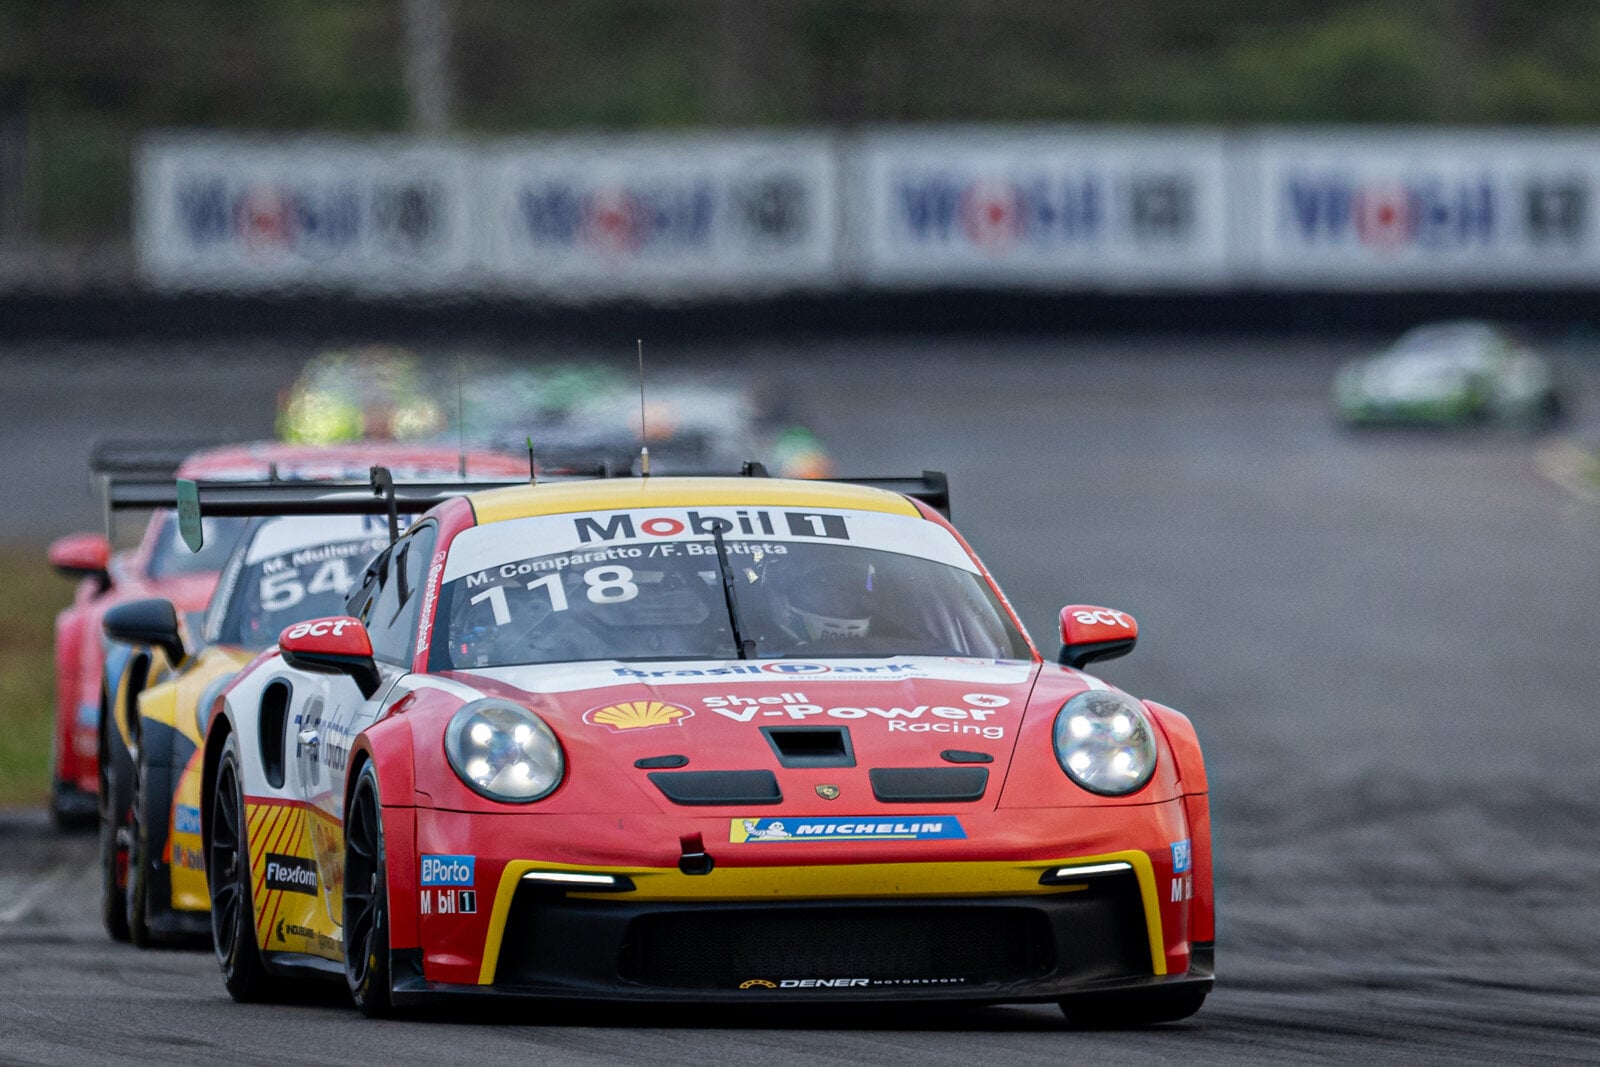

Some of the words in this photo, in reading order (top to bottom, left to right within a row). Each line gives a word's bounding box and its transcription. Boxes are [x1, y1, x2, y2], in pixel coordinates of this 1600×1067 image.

[574, 511, 775, 543] Mobil
[466, 571, 494, 589] M.
[500, 547, 642, 578] Comparatto
[260, 558, 355, 613] 54
[470, 565, 639, 626] 118
[288, 619, 352, 639] act
[1072, 609, 1130, 629] act
[613, 664, 762, 678] Brasil
[702, 693, 809, 708] Shell
[712, 704, 996, 722] V-Power
[888, 720, 1005, 739] Racing
[796, 823, 942, 835] MICHELIN
[266, 862, 318, 888] Flexform
[433, 859, 470, 882] Porto
[420, 890, 456, 914] Mbil
[780, 978, 869, 988] DENER
